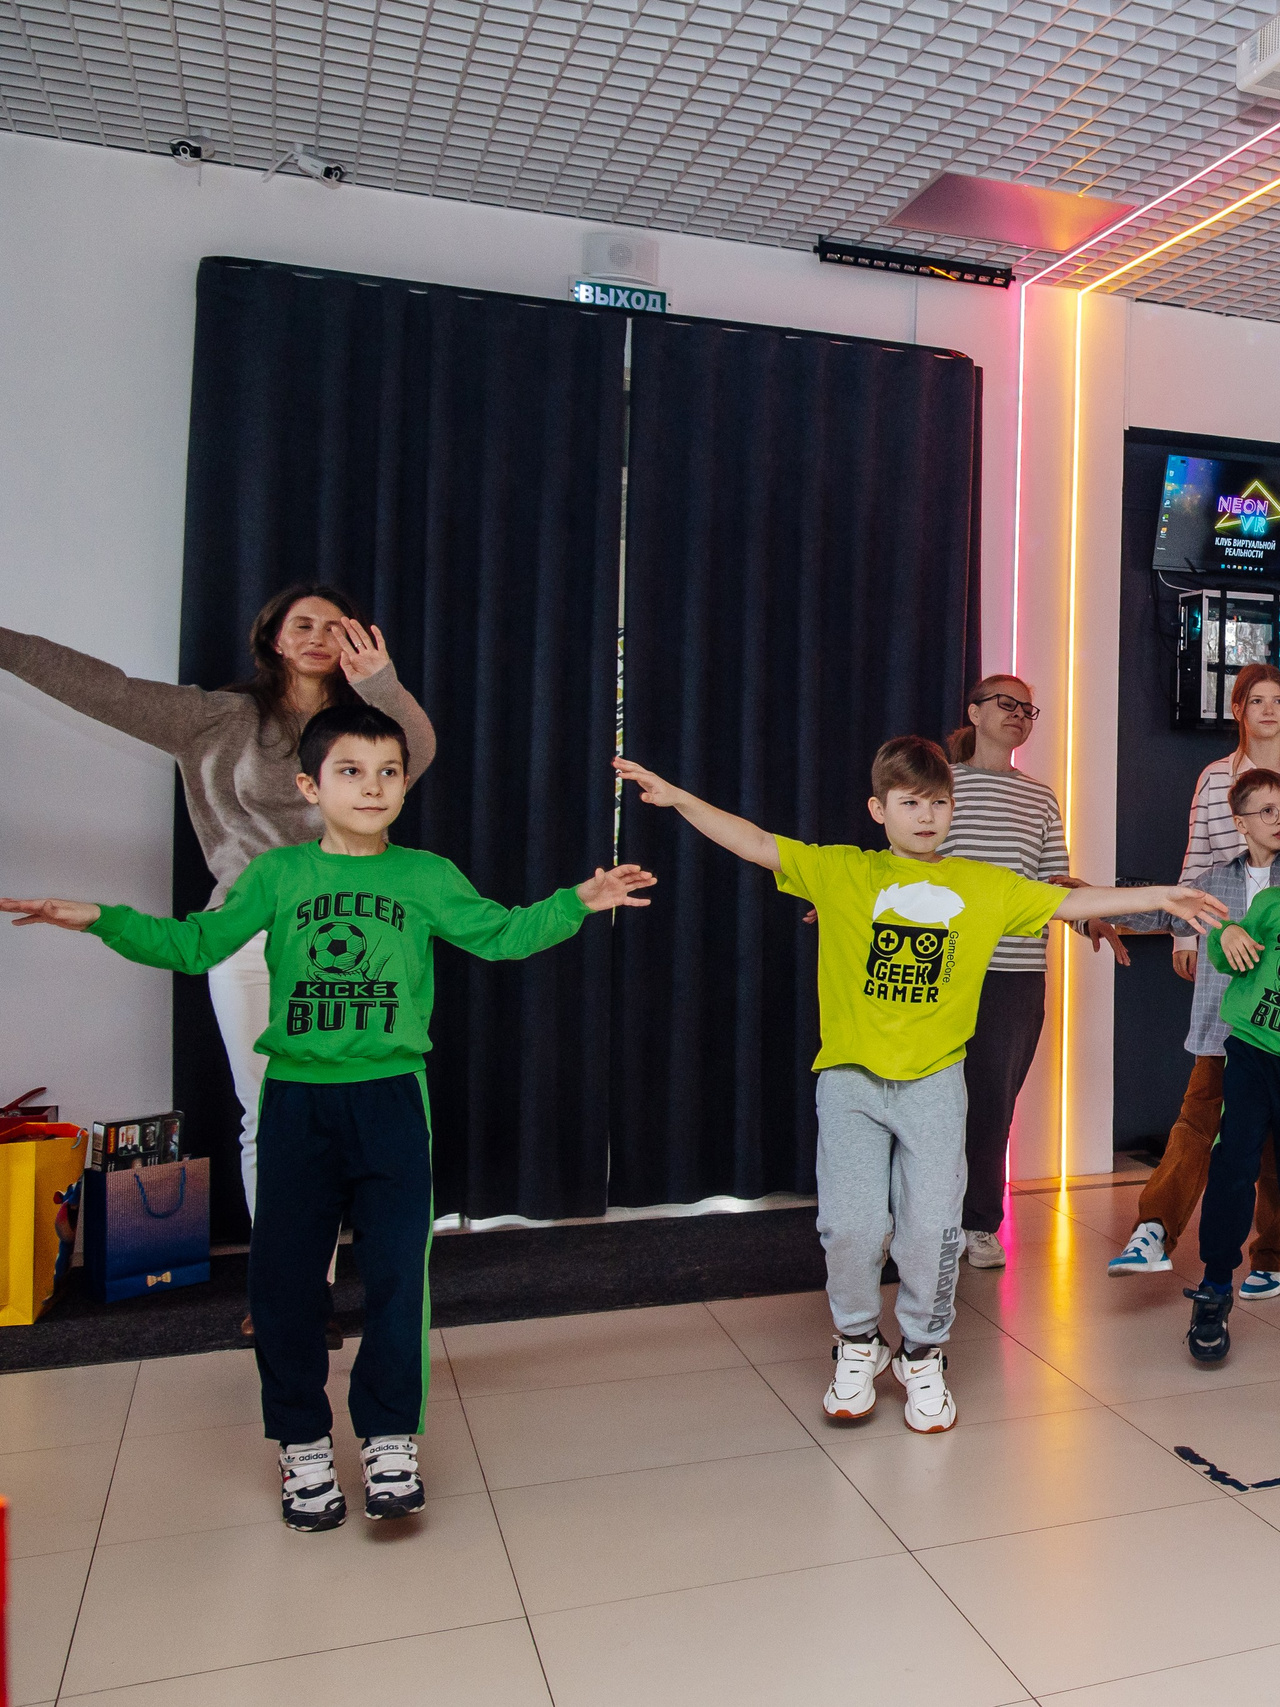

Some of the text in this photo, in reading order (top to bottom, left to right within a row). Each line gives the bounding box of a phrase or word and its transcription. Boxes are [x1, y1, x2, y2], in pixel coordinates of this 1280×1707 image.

[579, 283, 663, 312] ВЫХОД
[1217, 496, 1269, 516] NEON
[1240, 515, 1268, 533] VR
[1214, 537, 1276, 550] КЛУБ ВИРТУАЛЬНОЙ
[1224, 547, 1264, 559] РЕАЛЬНОСТИ
[296, 891, 407, 932] SOCCER
[875, 961, 929, 985] GEEK
[306, 984, 388, 996] KICKS
[863, 978, 940, 1003] GAMER
[286, 1000, 399, 1036] BUTT
[298, 1452, 329, 1462] adidas
[369, 1444, 399, 1453] adidas
